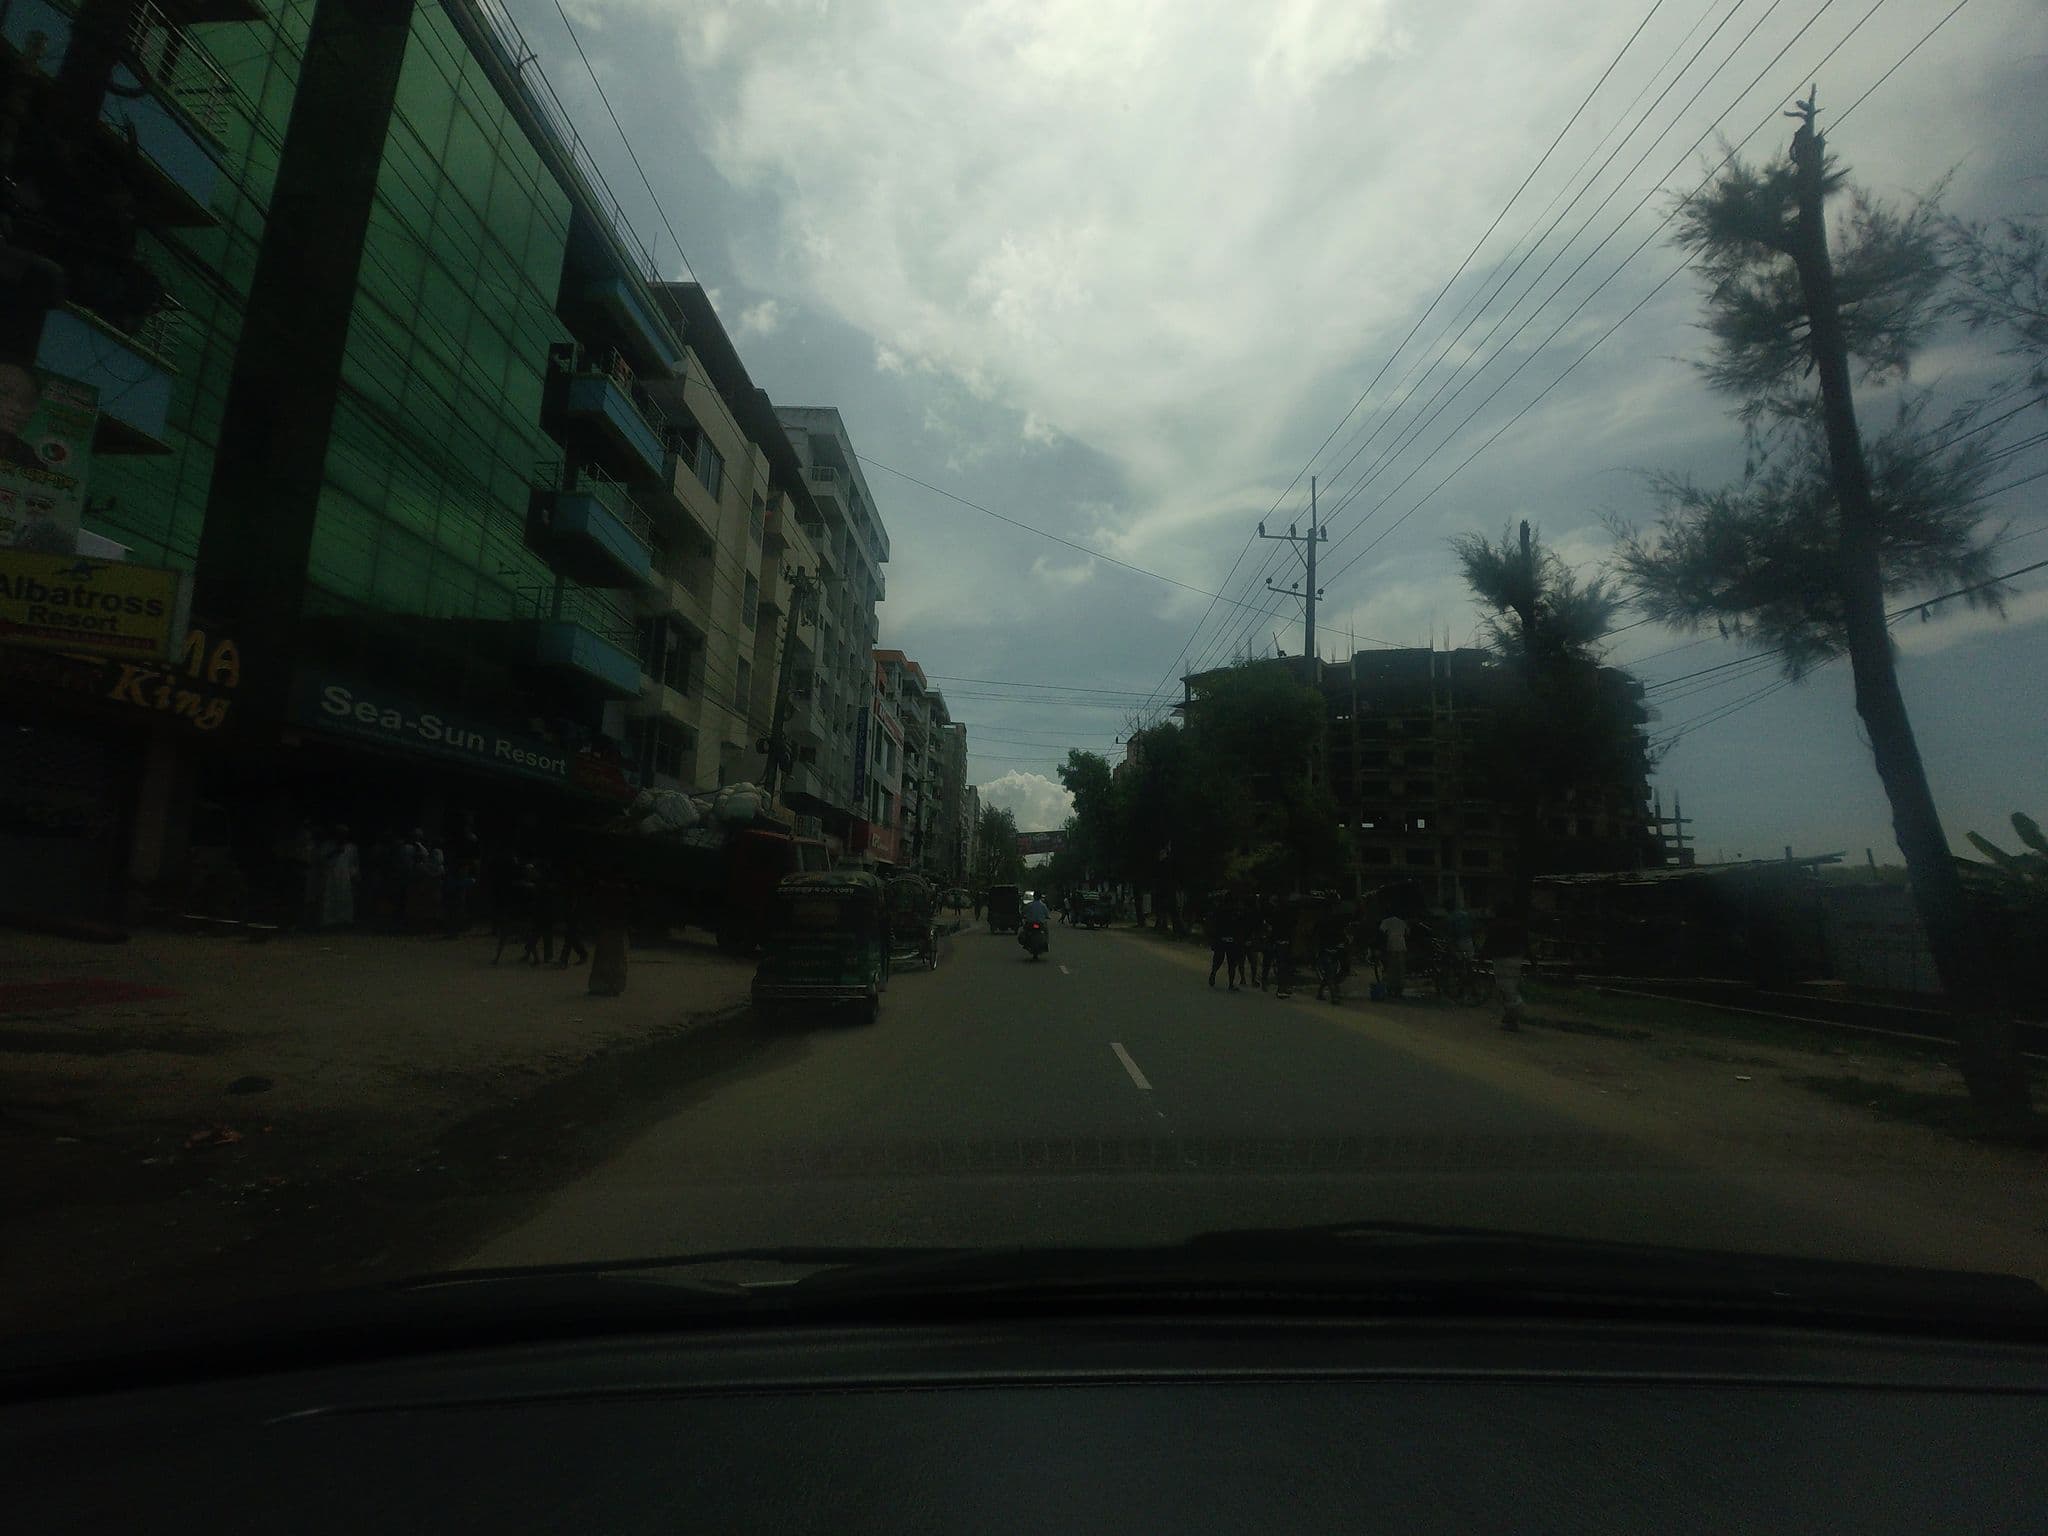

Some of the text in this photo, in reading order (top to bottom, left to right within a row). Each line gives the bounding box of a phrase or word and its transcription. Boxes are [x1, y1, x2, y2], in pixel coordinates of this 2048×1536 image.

[0, 573, 164, 618] Albatross
[28, 604, 117, 631] Resort
[110, 663, 231, 731] King
[320, 685, 485, 752] Sea-Sun
[494, 738, 567, 774] Resort
